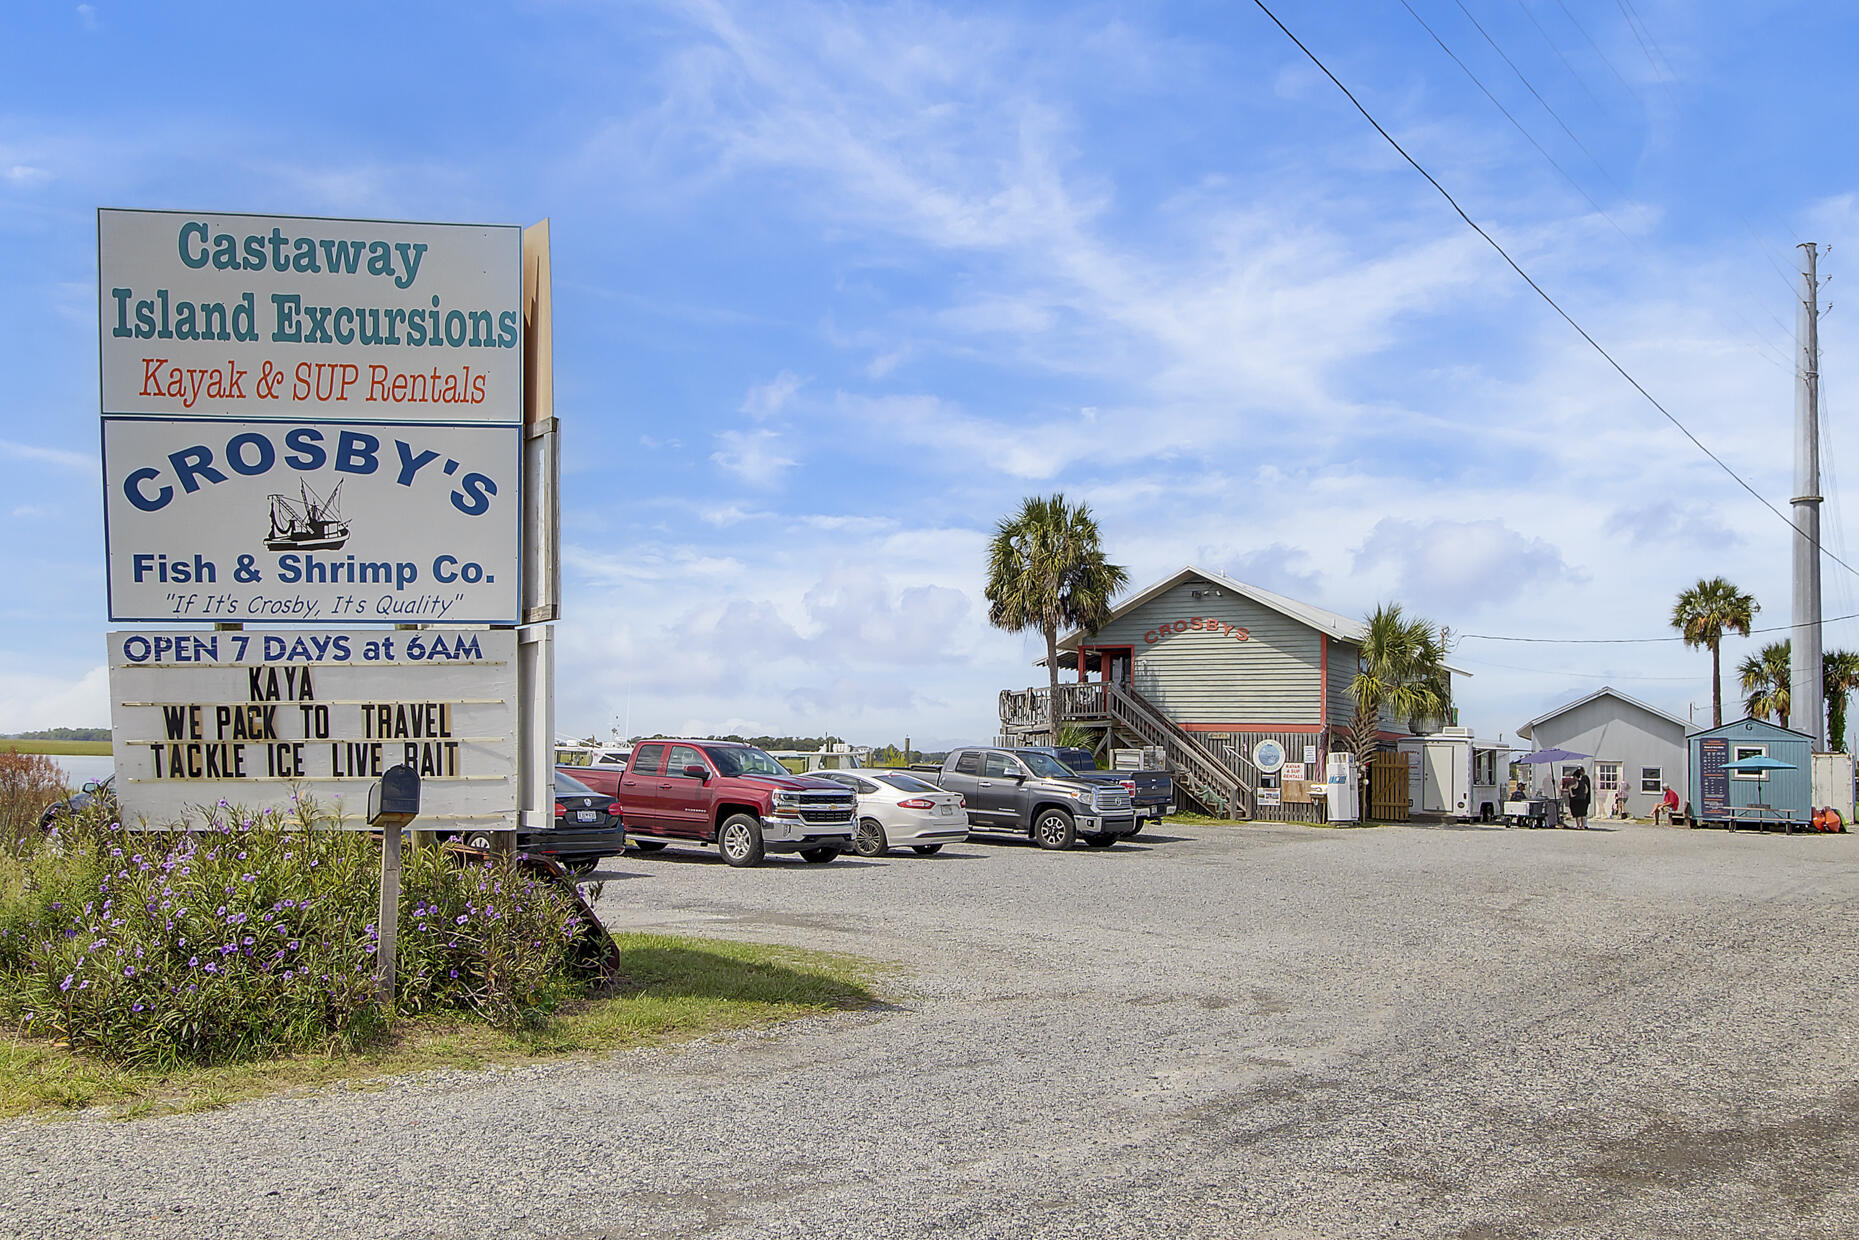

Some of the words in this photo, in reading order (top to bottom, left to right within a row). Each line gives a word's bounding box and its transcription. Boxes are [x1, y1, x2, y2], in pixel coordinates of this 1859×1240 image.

[178, 221, 428, 289] Castaway
[111, 288, 259, 343] Island
[271, 294, 518, 348] Excursions
[139, 358, 247, 408] Kayak
[256, 360, 285, 400] &
[292, 362, 359, 402] SUP
[366, 364, 486, 404] Rentals
[123, 428, 498, 516] CROSBY'S
[133, 554, 217, 583] Fish
[233, 554, 263, 583] &
[278, 554, 418, 590] Shrimp
[432, 555, 495, 583] Co.
[166, 593, 198, 614] "If
[203, 593, 239, 614] It's
[248, 595, 321, 619] Crosby,
[376, 593, 464, 619] Quality"
[123, 636, 219, 662] OPEN
[230, 635, 249, 662] 7
[263, 635, 352, 662] DAYS
[364, 637, 396, 661] at
[406, 634, 483, 661] 6AM
[1144, 616, 1250, 644] CROSBYS
[249, 666, 314, 701] KAYA
[164, 705, 203, 740] WE
[216, 705, 278, 740] PACK
[299, 704, 330, 739] TO
[361, 703, 451, 738] TRAVEL
[150, 743, 247, 778] TACKLE
[268, 742, 306, 777] ICE
[331, 742, 384, 777] LIVE
